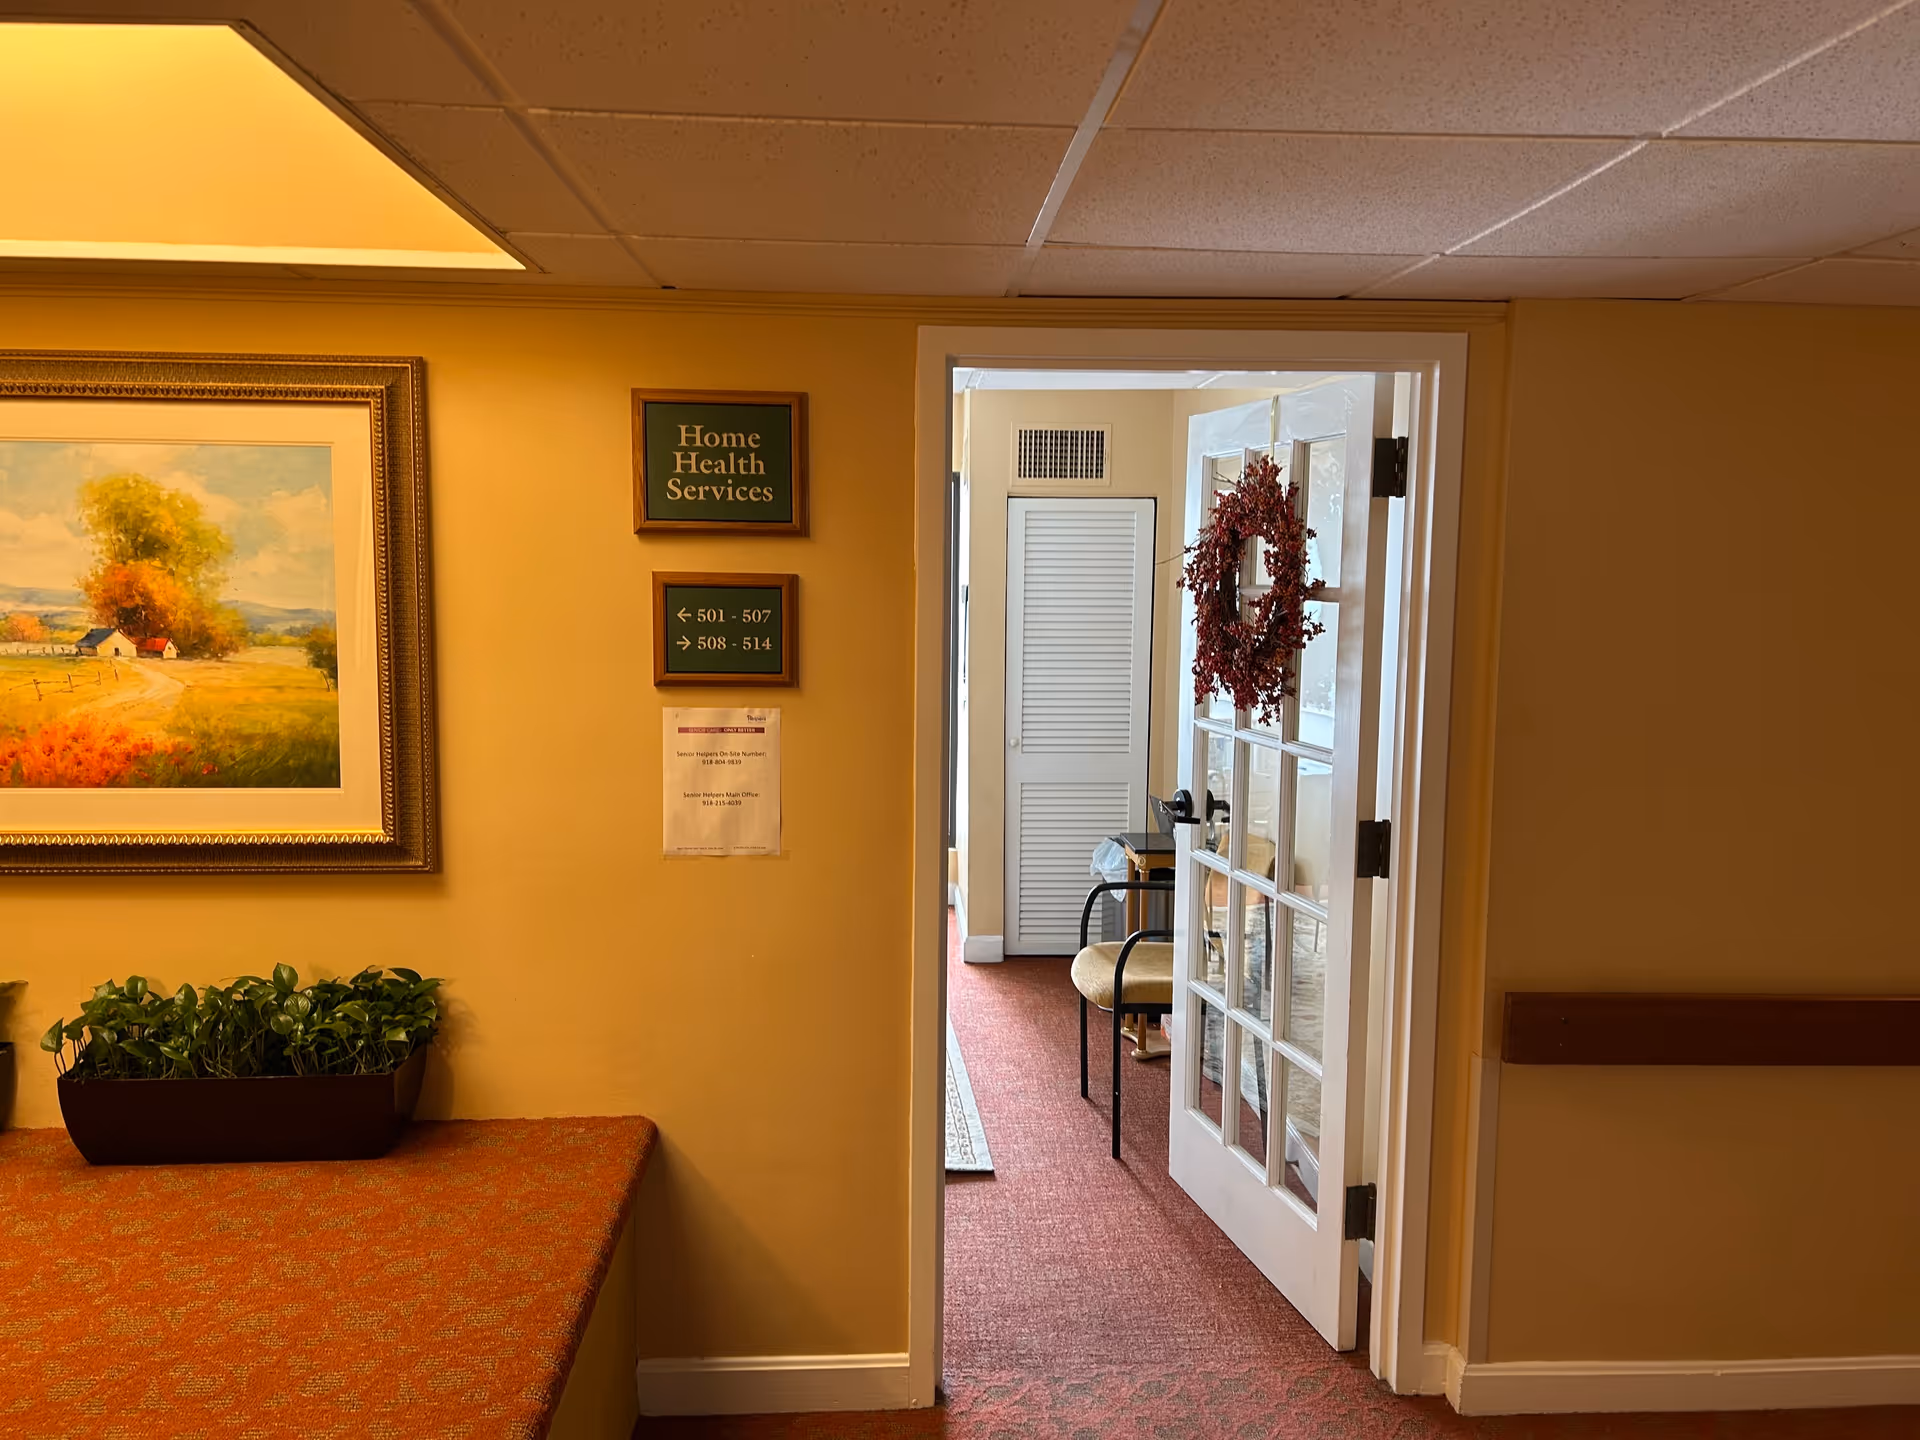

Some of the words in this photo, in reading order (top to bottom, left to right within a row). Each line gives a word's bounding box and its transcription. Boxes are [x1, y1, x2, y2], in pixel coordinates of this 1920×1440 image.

[677, 424, 761, 448] Home
[672, 451, 766, 475] Health
[666, 477, 774, 502] Services
[697, 608, 726, 623] 501
[742, 609, 772, 623] 507
[697, 636, 727, 650] 508
[742, 637, 772, 651] 514
[696, 750, 719, 758] Helpers
